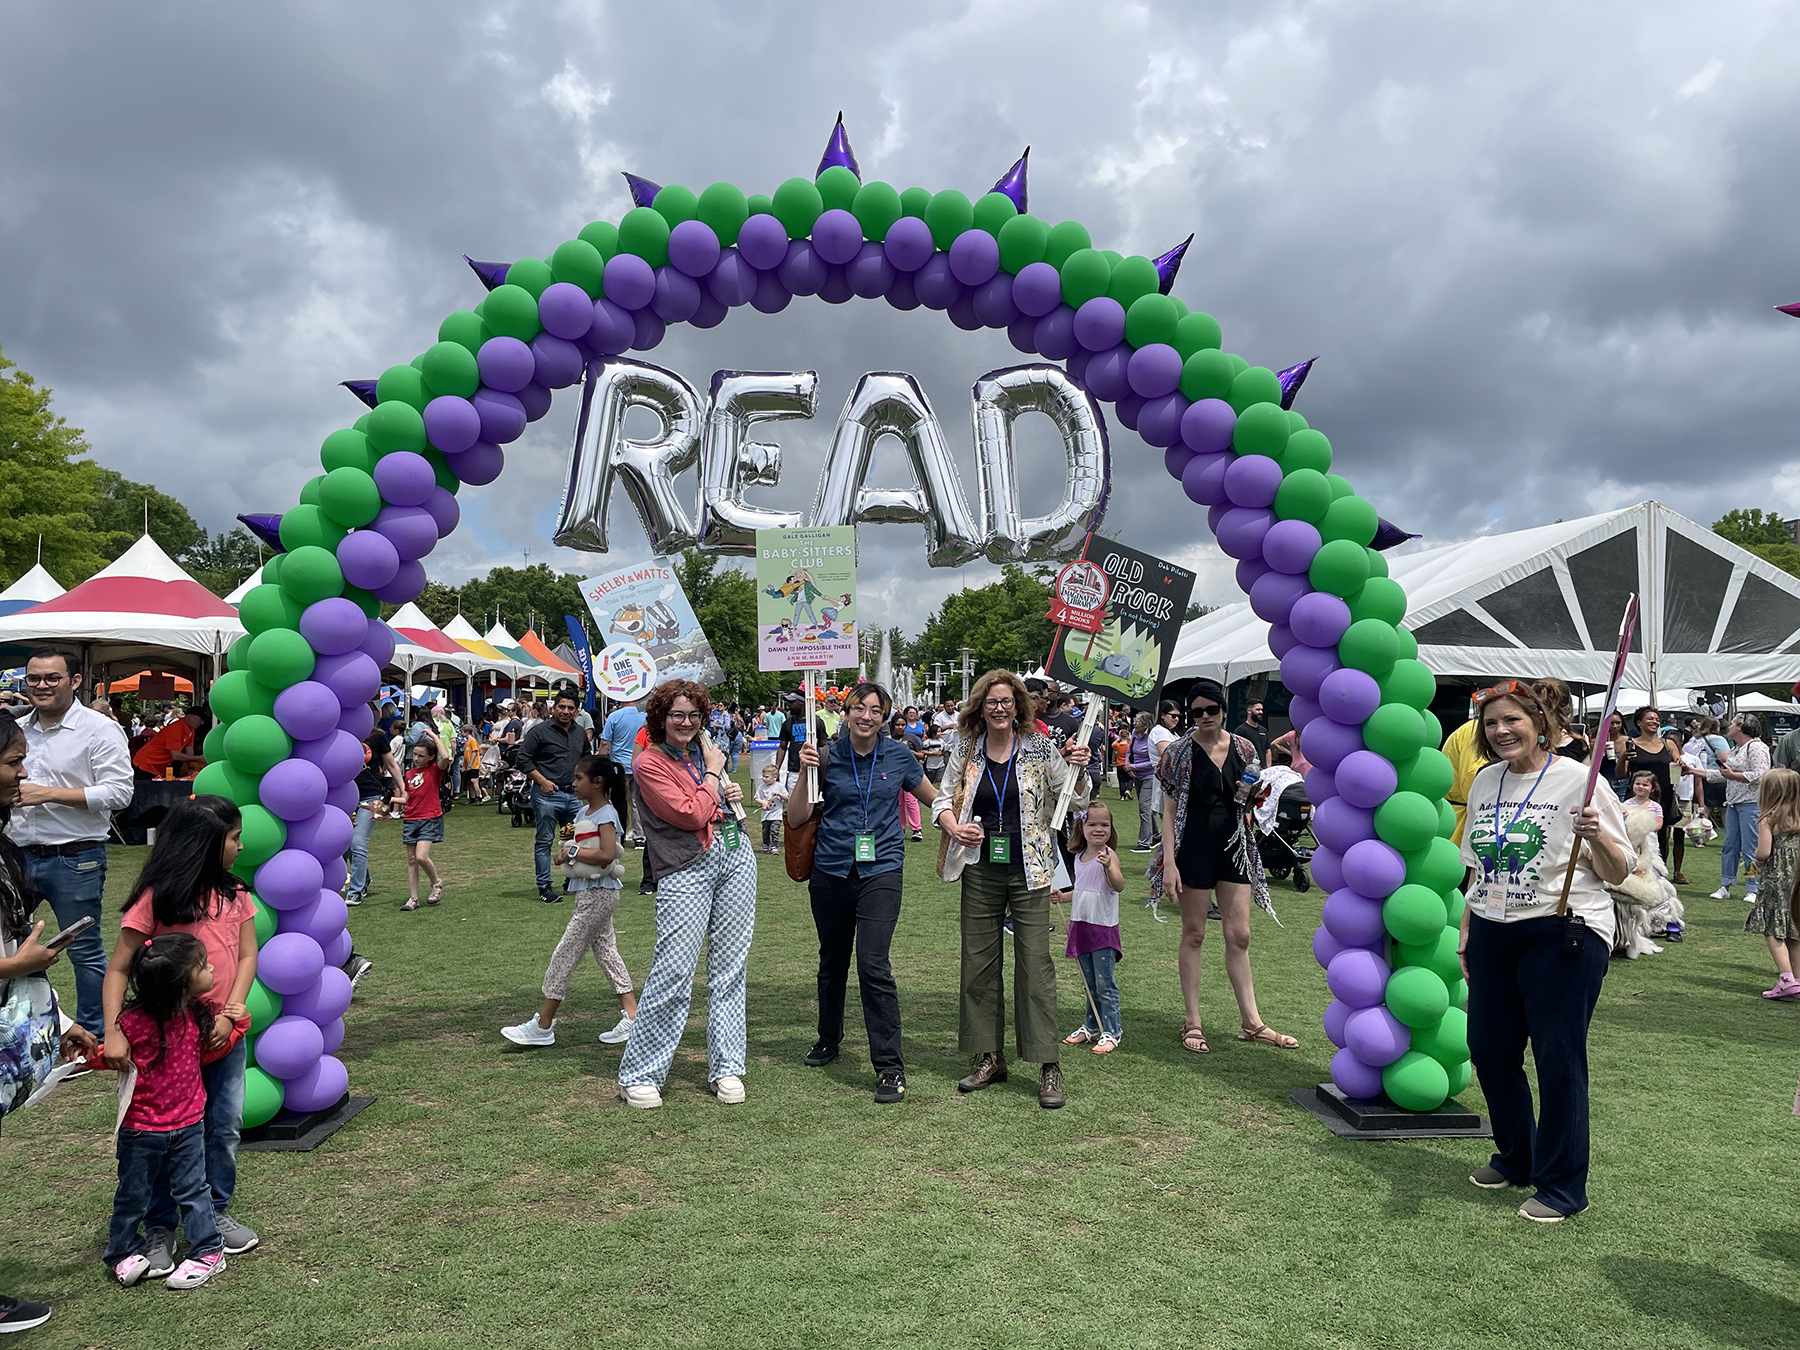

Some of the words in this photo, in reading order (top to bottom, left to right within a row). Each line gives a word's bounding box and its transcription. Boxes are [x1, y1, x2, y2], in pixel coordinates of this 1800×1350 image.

[552, 355, 1113, 568] READ
[762, 545, 852, 559] BABY-SITTERS
[790, 558, 824, 569] CLUB
[1102, 552, 1144, 584] OLD
[1157, 561, 1169, 571] Deb
[588, 574, 627, 602] SHELBY
[627, 575, 635, 583] &
[632, 568, 670, 581] WATTS
[605, 598, 620, 606] Tide
[620, 592, 636, 601] Pool
[637, 583, 664, 596] Troubles
[1109, 580, 1174, 621] ROCK
[1056, 607, 1067, 623] 4
[1070, 609, 1096, 620] MILLION
[1069, 615, 1090, 625] BOOKS
[1138, 614, 1160, 629] boring)
[613, 658, 632, 671] ONE
[616, 667, 635, 679] BOOK
[1526, 801, 1560, 811] begins
[1477, 889, 1488, 898] yo
[1506, 889, 1537, 901] brary!
[1515, 899, 1541, 907] LIBRARY
